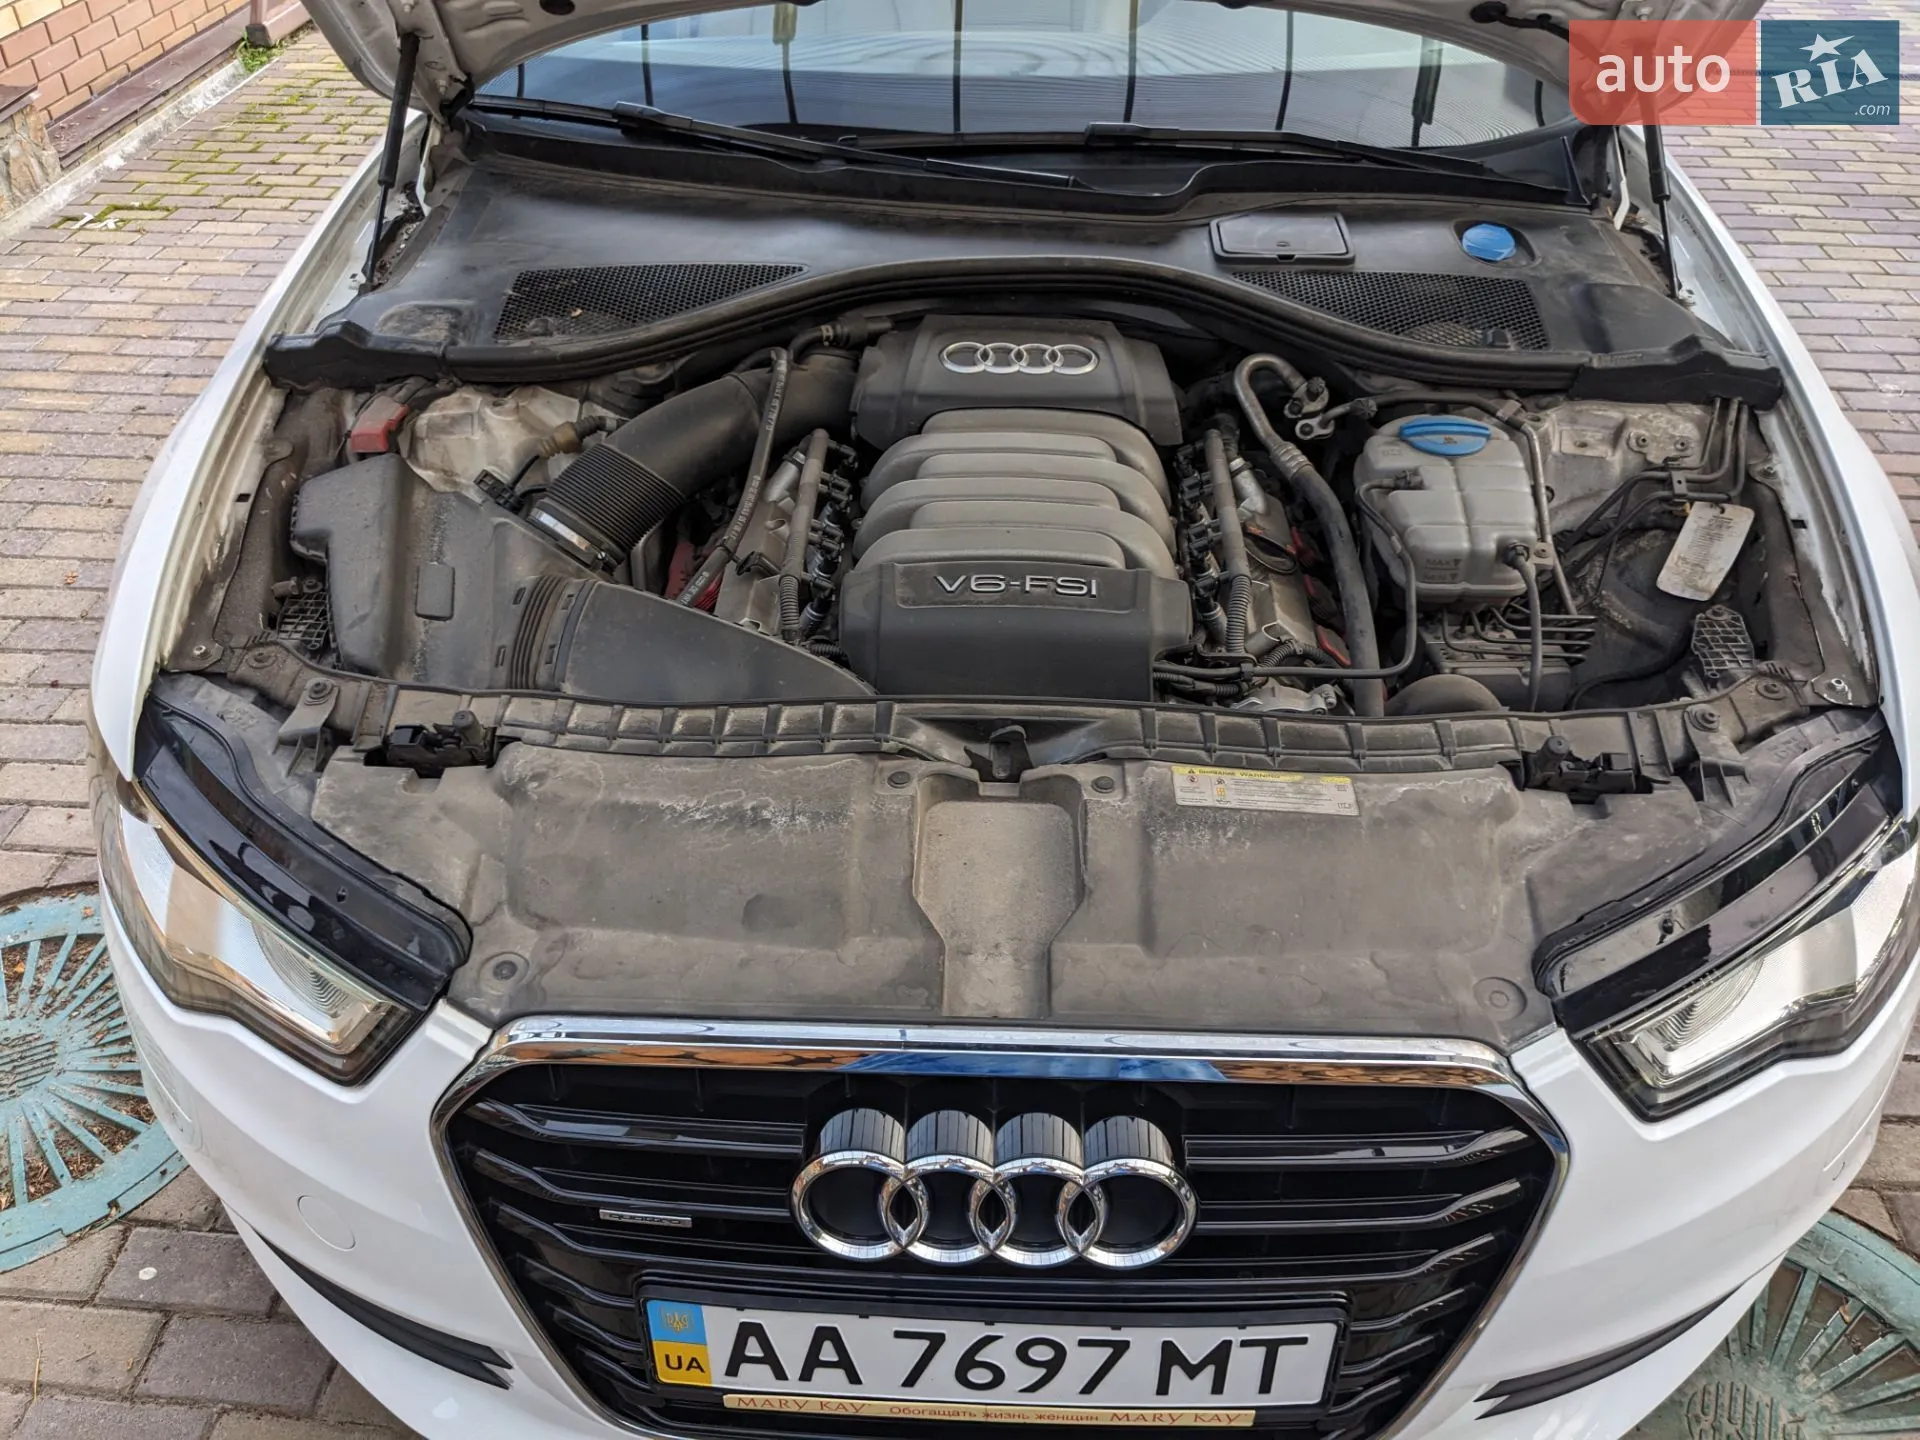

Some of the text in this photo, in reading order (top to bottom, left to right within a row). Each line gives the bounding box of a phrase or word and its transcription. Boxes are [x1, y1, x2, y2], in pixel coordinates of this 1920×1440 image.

[934, 574, 1098, 598] V6-FSI
[608, 1213, 681, 1225] quattro
[664, 1353, 706, 1374] UA
[724, 1321, 1309, 1396] AA 7697 MT
[736, 1397, 867, 1414] MARY KAY
[889, 1405, 1100, 1422] Обогащать жизнь женщин
[1110, 1411, 1242, 1424] MARY KAY
